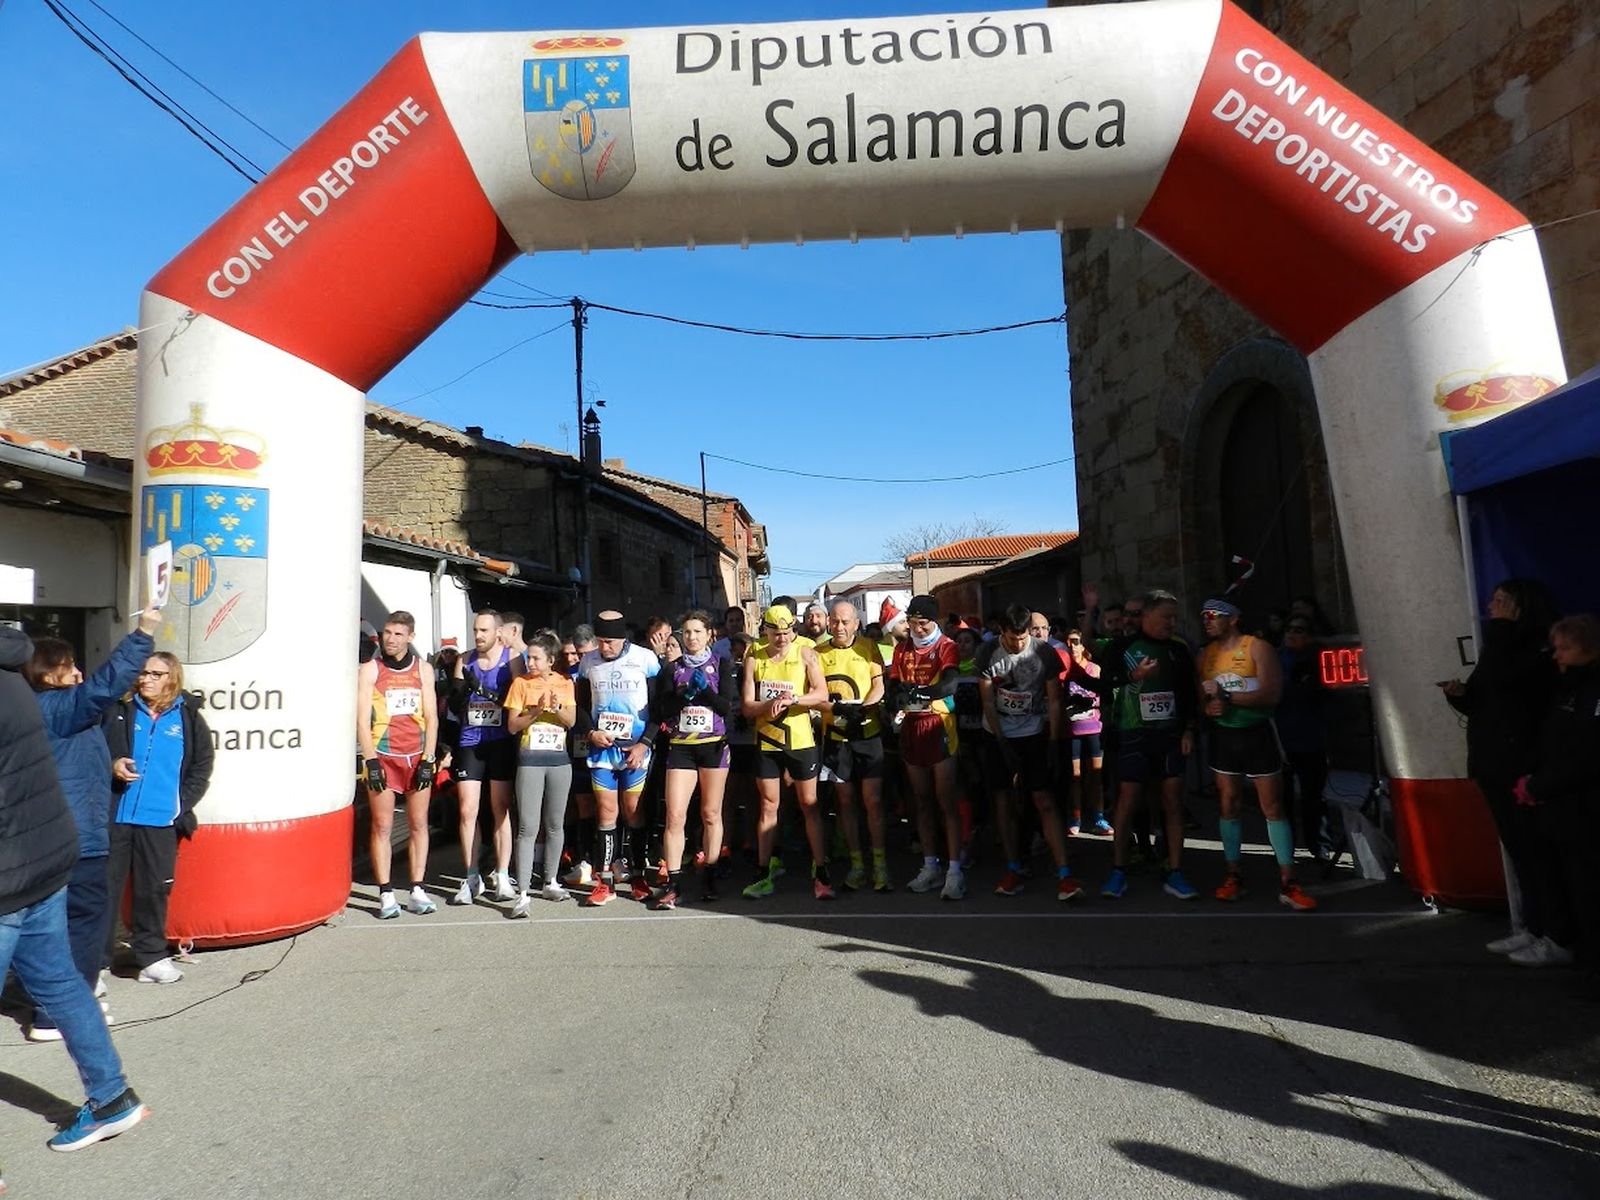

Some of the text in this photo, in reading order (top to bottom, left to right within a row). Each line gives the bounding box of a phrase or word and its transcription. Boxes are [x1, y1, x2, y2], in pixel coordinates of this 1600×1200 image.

[675, 16, 1053, 86] Diputación
[675, 92, 1127, 172] de Salamanca
[1234, 47, 1479, 224] CON NUESTROS
[1211, 88, 1436, 253] DEPORTISTAS
[206, 96, 429, 299] CON EL DEPORTE
[156, 561, 168, 600] 5
[191, 680, 283, 711] ación
[1003, 698, 1025, 709] 262
[1148, 701, 1170, 713] 259
[474, 709, 495, 719] 267
[605, 721, 626, 732] 279
[686, 715, 706, 726] 253
